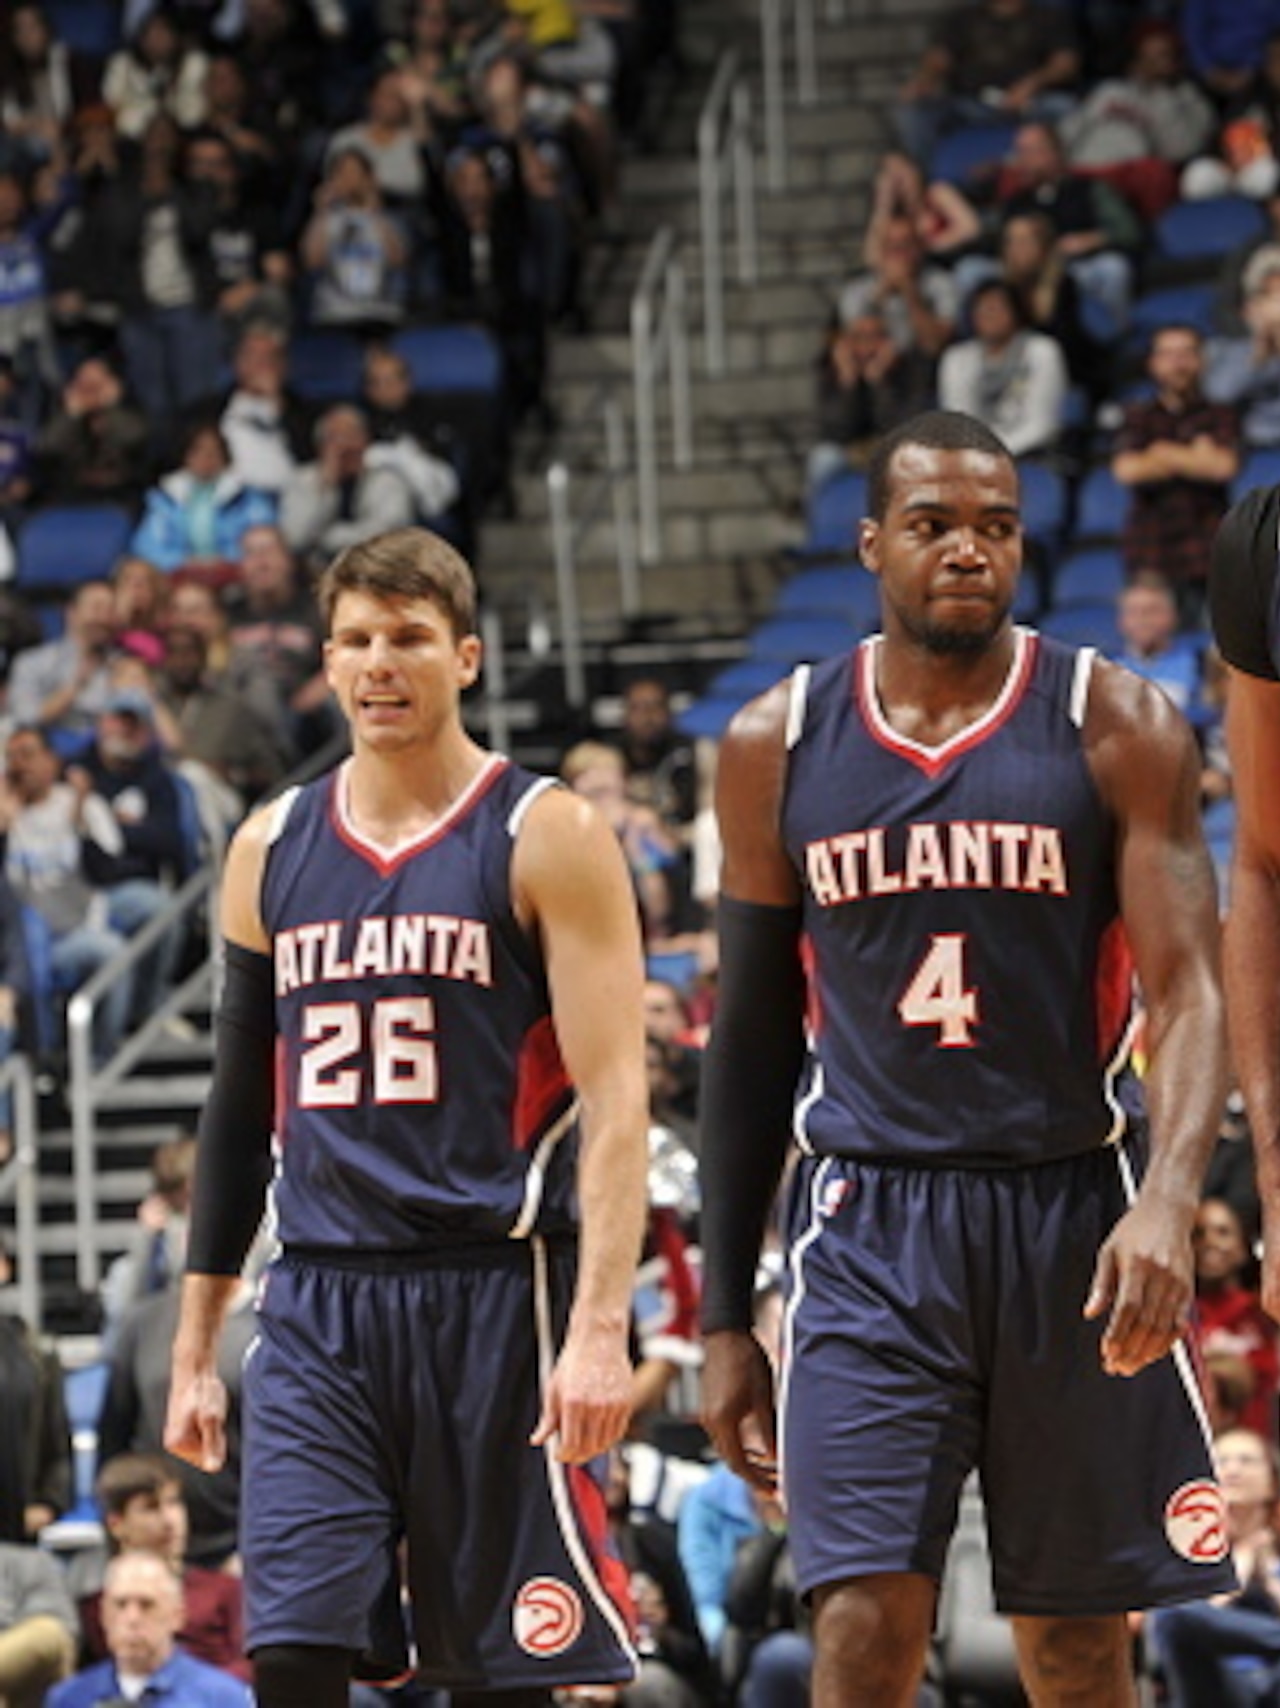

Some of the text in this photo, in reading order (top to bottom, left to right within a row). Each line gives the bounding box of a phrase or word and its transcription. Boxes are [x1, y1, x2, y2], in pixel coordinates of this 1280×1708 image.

[804, 820, 1069, 908] ATLANTA
[273, 913, 494, 998] ATLANTA
[897, 932, 980, 1047] 4
[298, 995, 439, 1109] 26
